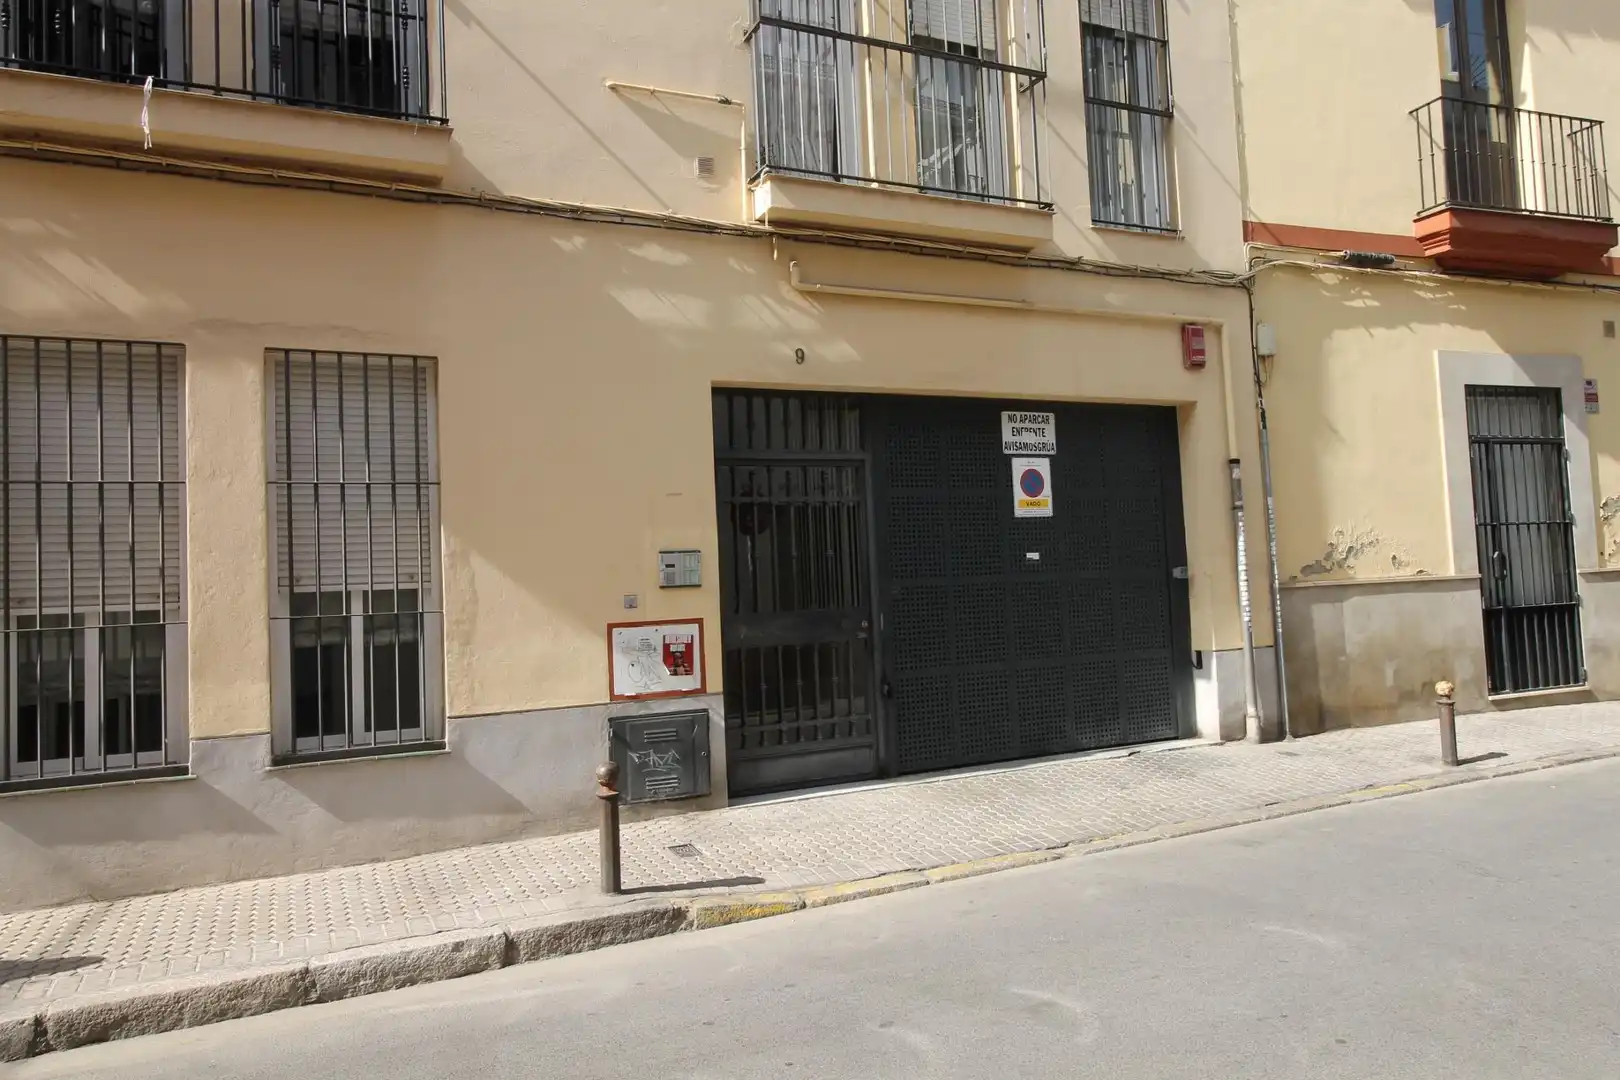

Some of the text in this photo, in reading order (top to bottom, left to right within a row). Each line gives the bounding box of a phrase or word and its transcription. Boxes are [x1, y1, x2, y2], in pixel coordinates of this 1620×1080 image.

[795, 347, 805, 365] 9
[1007, 413, 1050, 425] NO APARCAR
